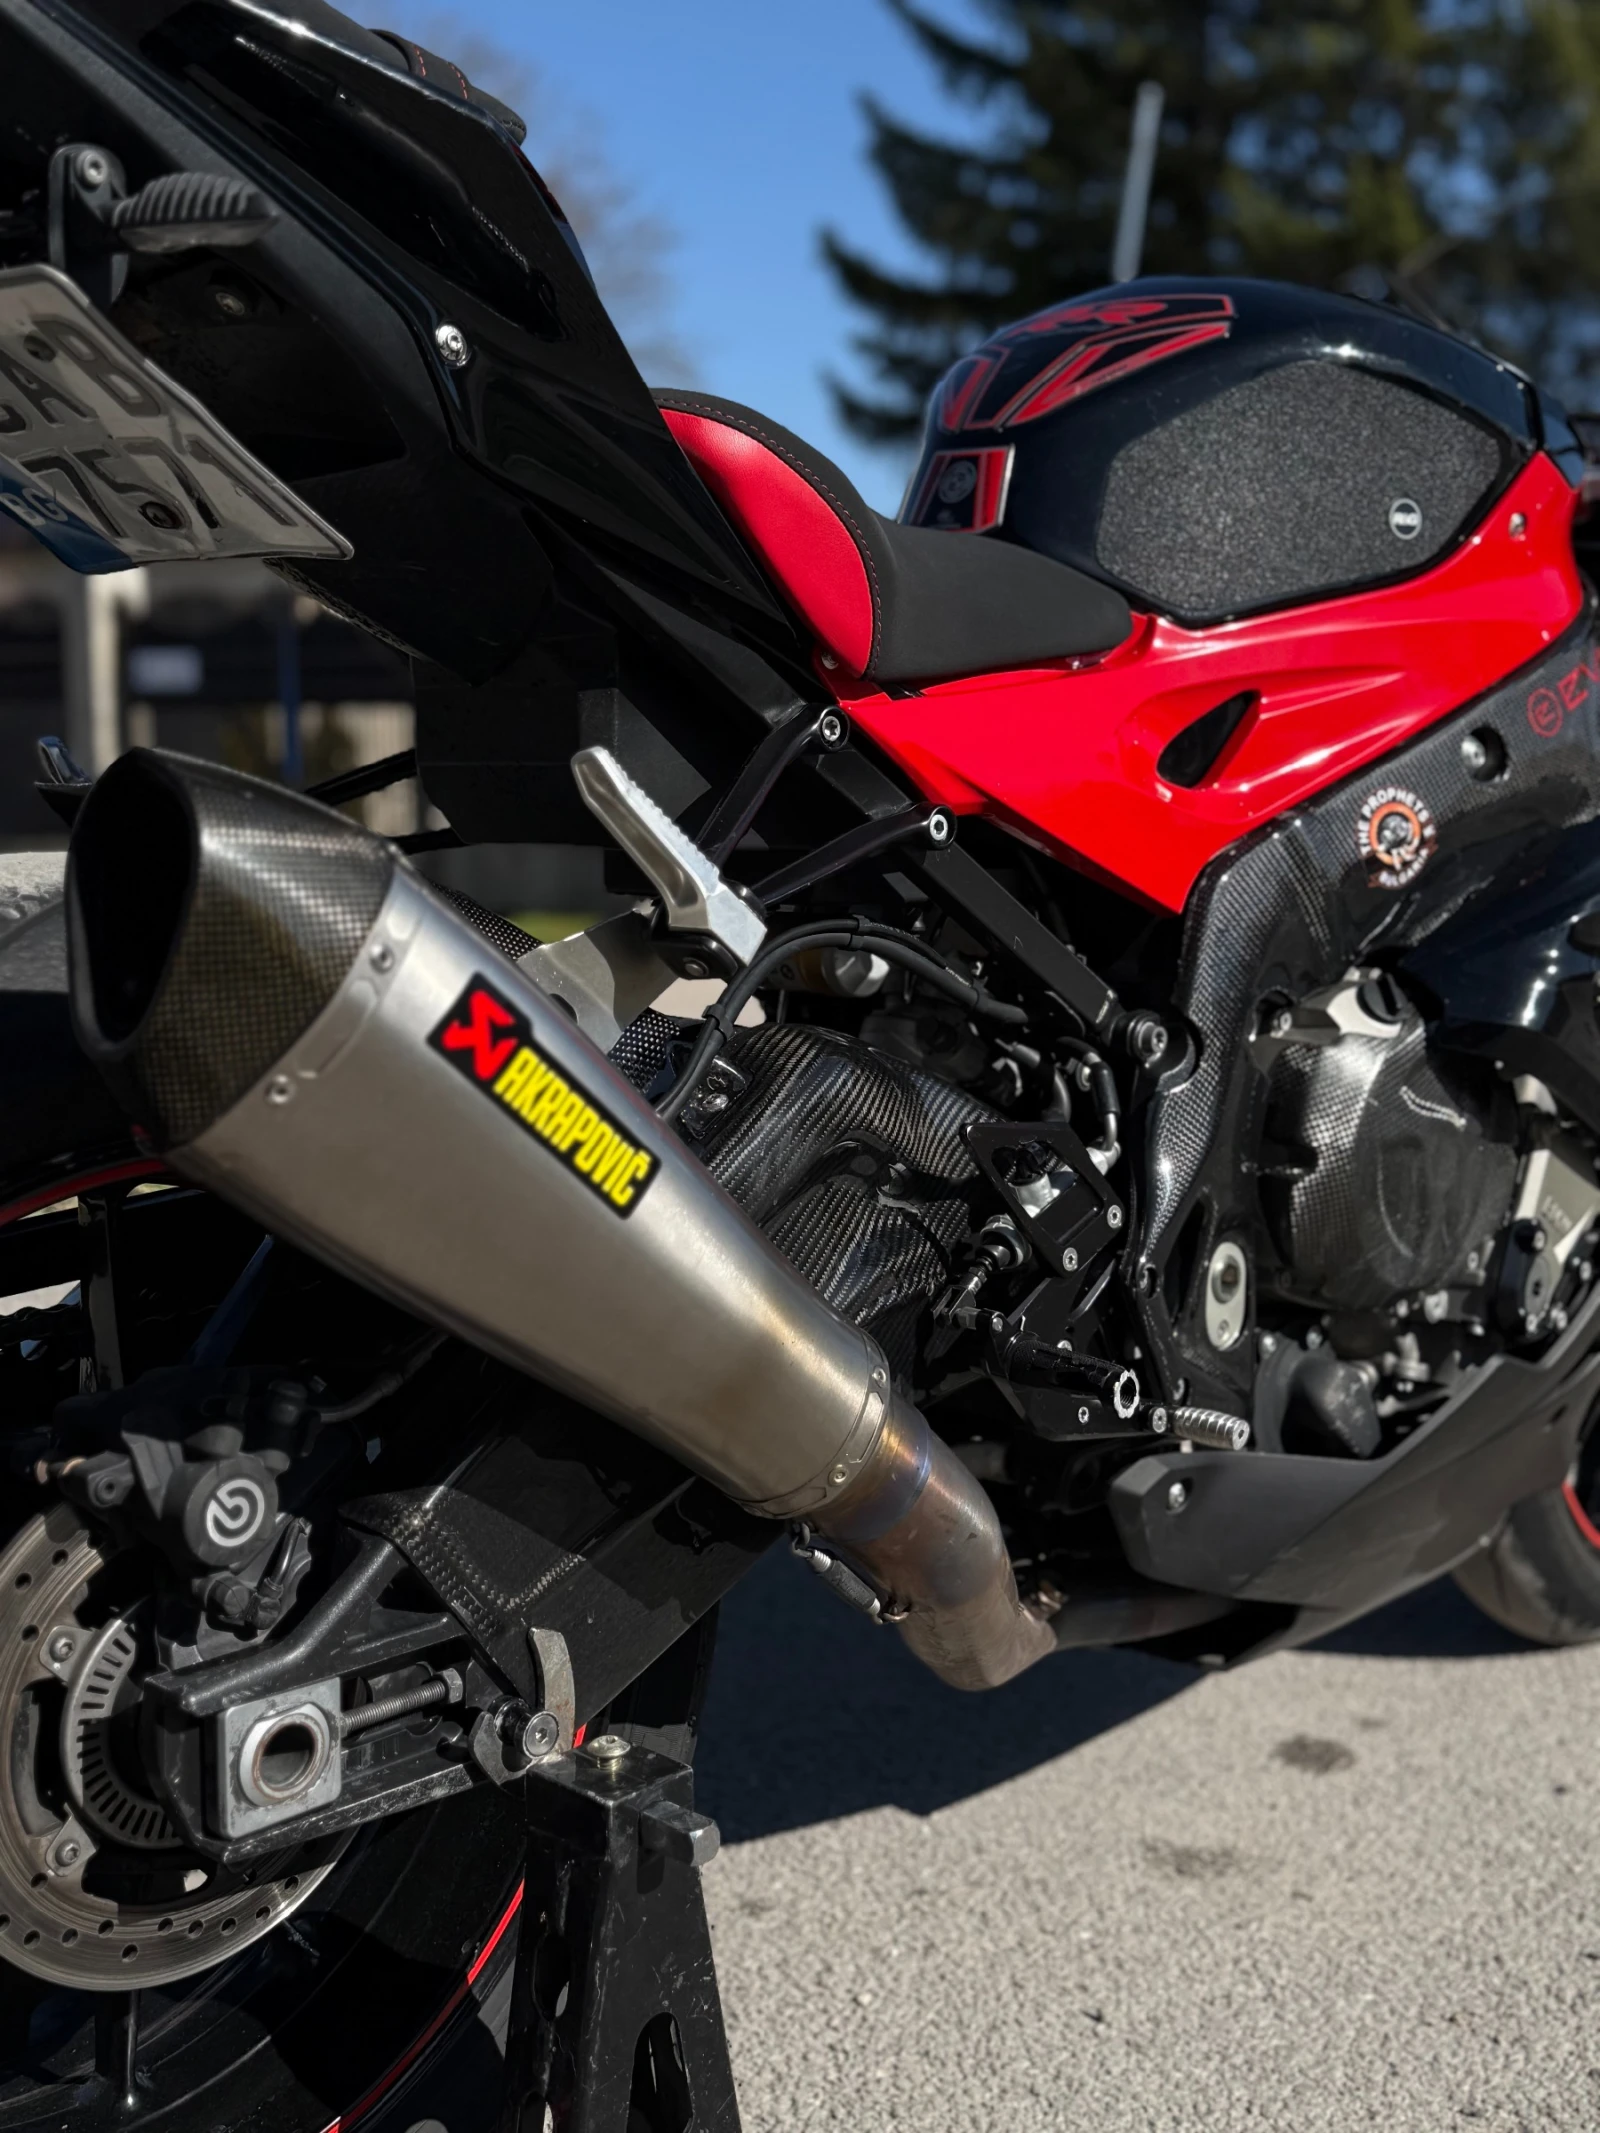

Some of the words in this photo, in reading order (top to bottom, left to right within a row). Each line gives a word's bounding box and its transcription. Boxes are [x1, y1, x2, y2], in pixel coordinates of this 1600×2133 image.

[0, 487, 69, 526] BG
[18, 437, 298, 538] 7571
[1361, 787, 1430, 823] PROPHETS
[1357, 819, 1372, 856] THE
